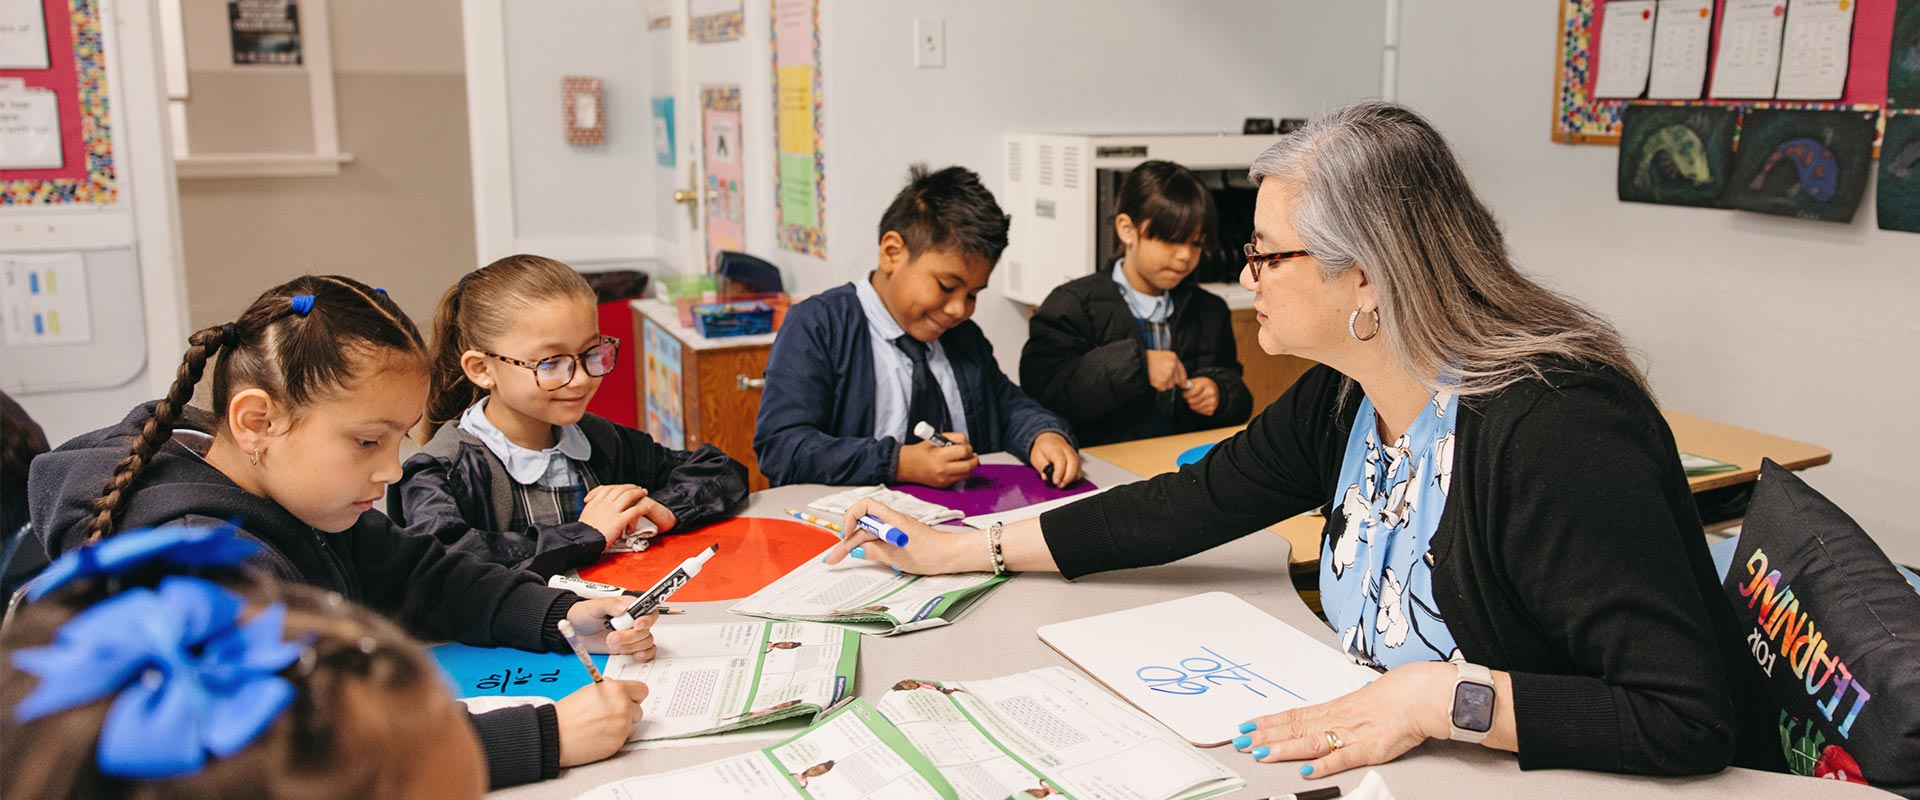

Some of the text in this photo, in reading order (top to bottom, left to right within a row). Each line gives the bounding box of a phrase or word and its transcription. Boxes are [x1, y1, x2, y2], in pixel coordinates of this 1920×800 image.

[658, 575, 688, 604] EXPO
[1739, 548, 1871, 739] LEARNING
[1747, 627, 1777, 678] FOR
[1136, 666, 1208, 695] 60
